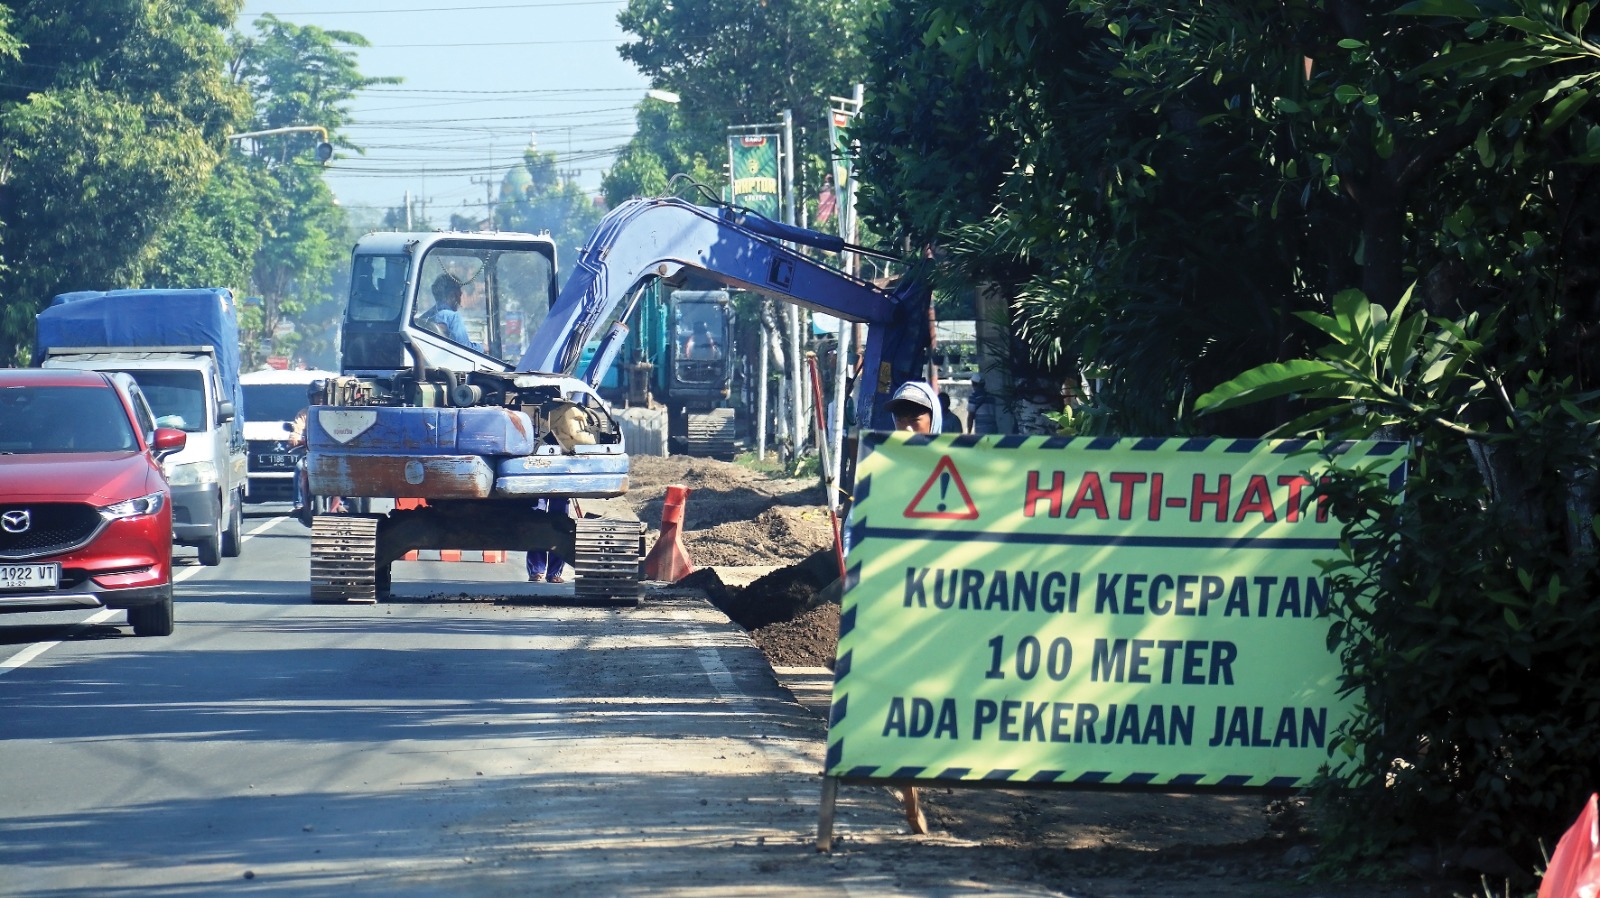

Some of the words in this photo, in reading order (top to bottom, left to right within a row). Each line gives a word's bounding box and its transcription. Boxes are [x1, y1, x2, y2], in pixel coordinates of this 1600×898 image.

[1023, 470, 1333, 524] HATI-HATI
[1, 567, 32, 580] 1922
[38, 566, 54, 579] VT
[903, 566, 1081, 614] KURANGI
[1094, 573, 1333, 619] KECEPATAN
[984, 634, 1073, 681] 100
[1090, 637, 1238, 686] METER
[882, 697, 959, 739] ADA
[972, 699, 1196, 747] PEKERJAAN
[1208, 705, 1328, 749] JALAN
